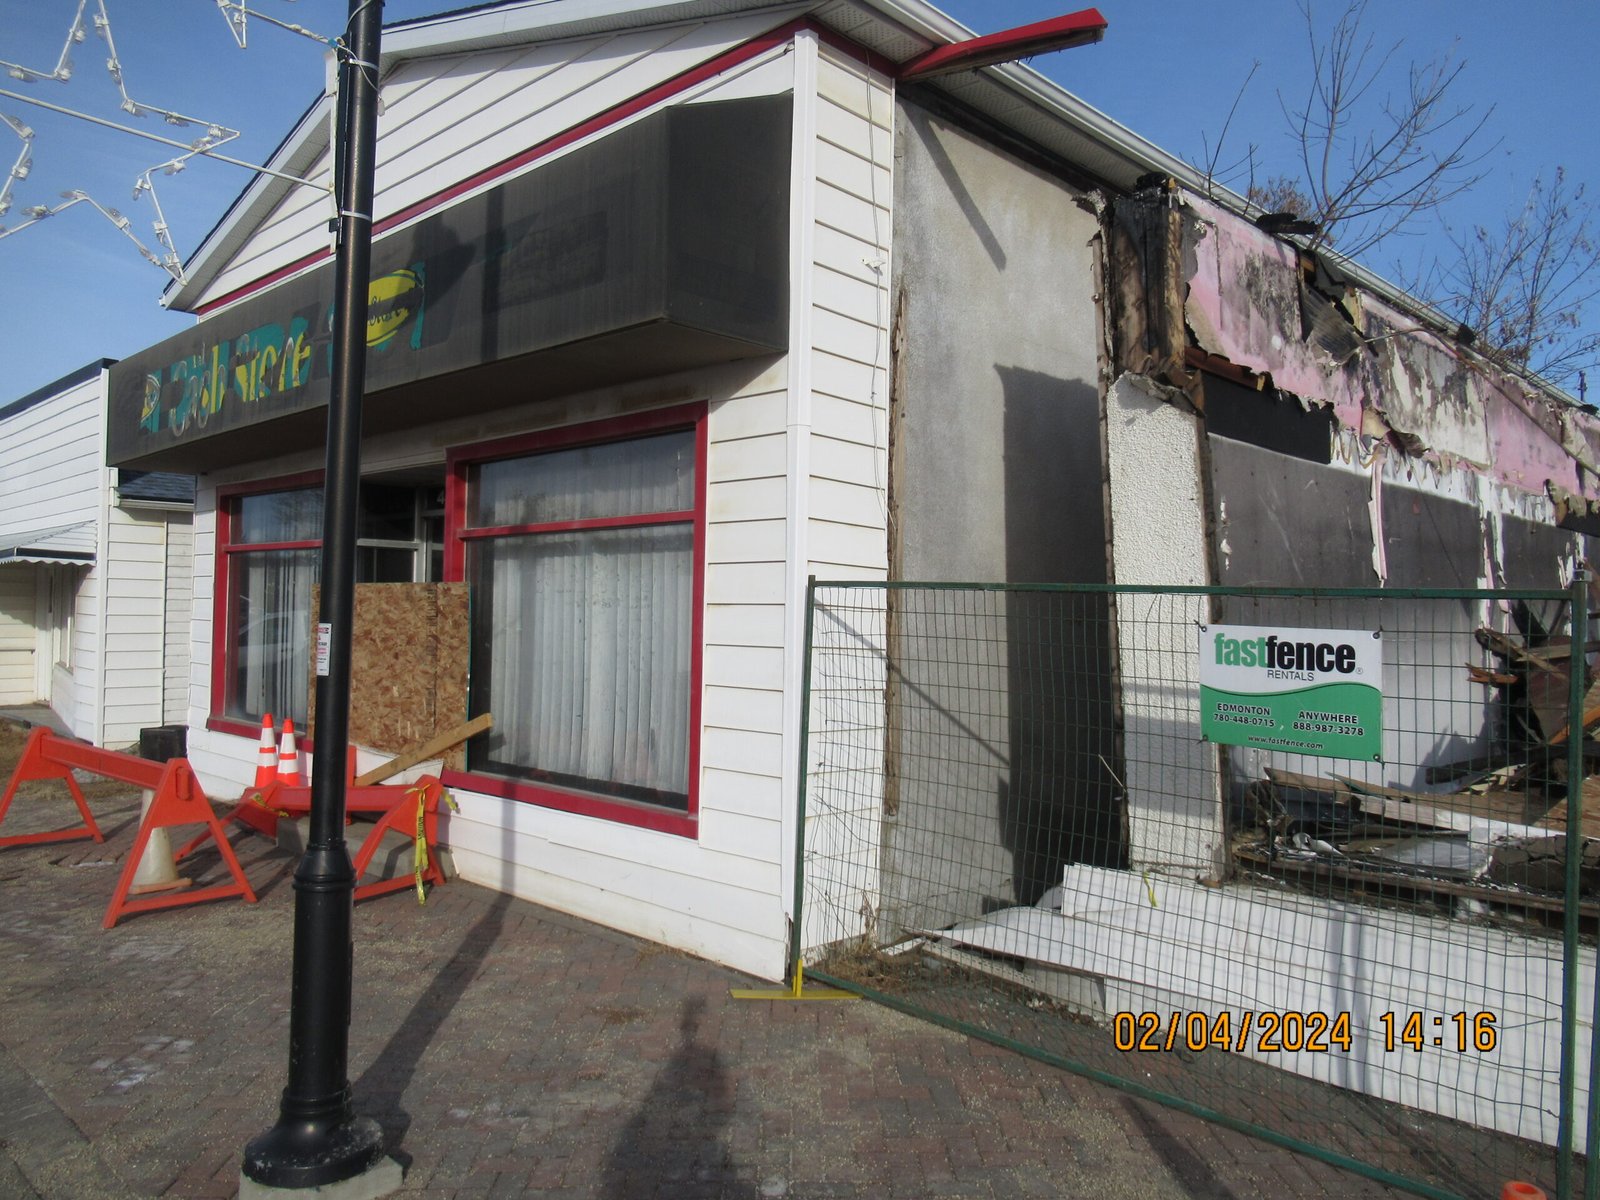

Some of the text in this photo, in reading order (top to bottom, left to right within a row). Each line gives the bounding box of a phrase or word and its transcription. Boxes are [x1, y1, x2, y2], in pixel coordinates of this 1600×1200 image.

[1267, 669, 1315, 682] RENTALS
[1217, 703, 1271, 716] EDMONTON
[1213, 713, 1275, 727] 780-448-0715
[1298, 711, 1358, 724] ANYWHERE
[1292, 721, 1364, 736] 888-987-3278
[1248, 736, 1323, 750] www.fastfence.com
